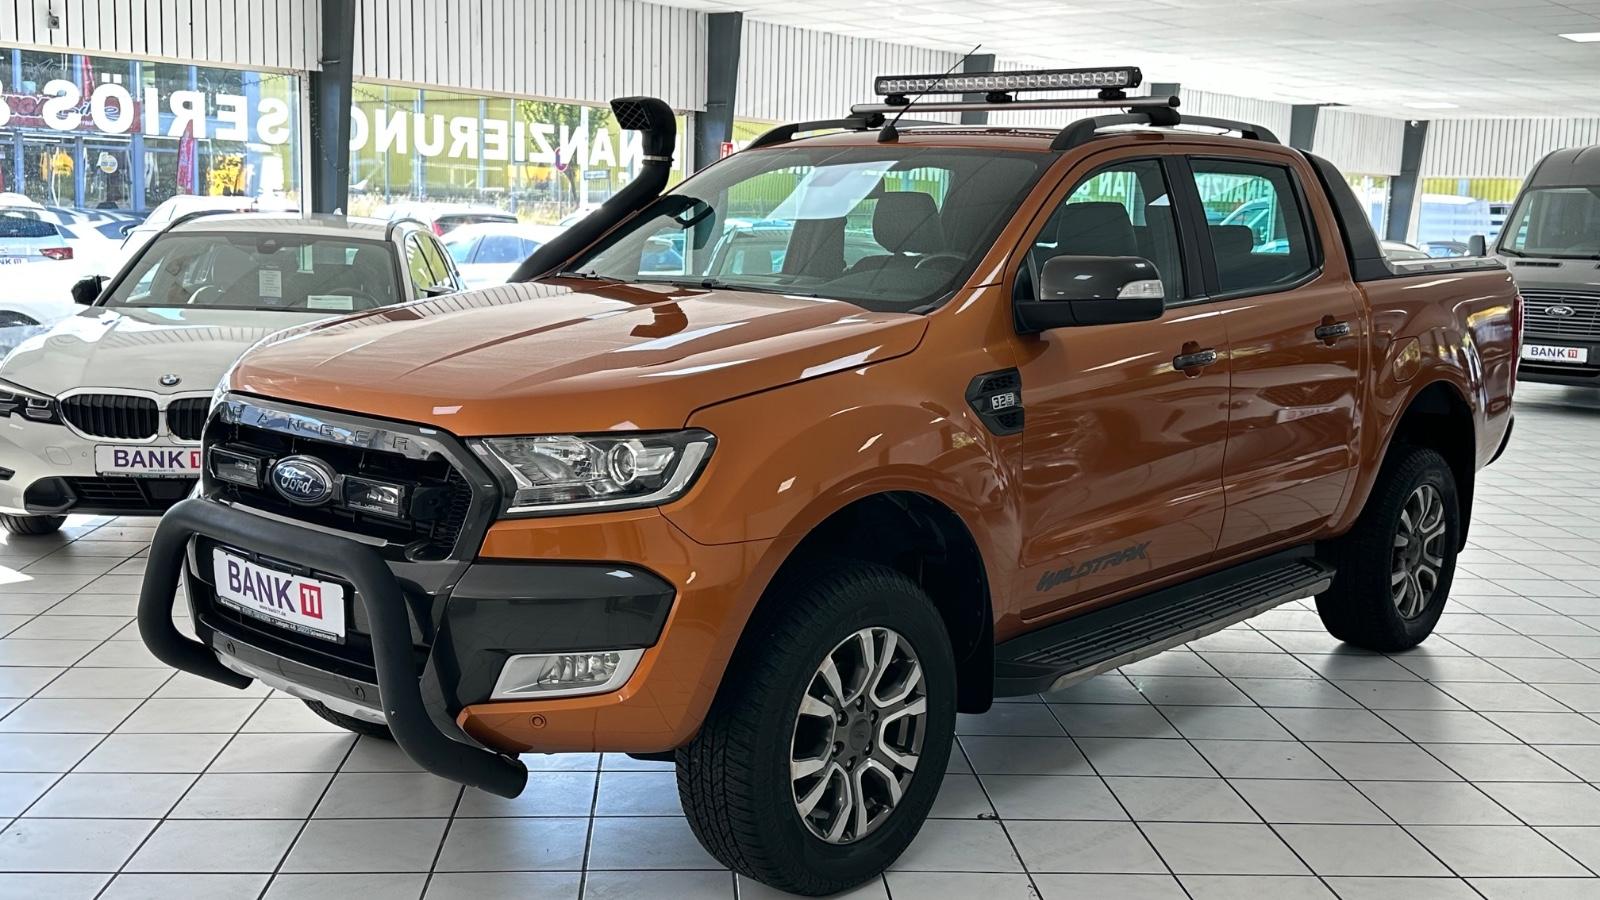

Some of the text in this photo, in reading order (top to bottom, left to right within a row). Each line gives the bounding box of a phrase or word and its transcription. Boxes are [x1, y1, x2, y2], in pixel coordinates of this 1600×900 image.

[1531, 347, 1566, 358] BANK
[230, 404, 410, 451] RANGER
[114, 449, 185, 468] BANK
[280, 467, 330, 496] Ford
[1035, 540, 1152, 592] WILDTRAK
[228, 560, 321, 617] BANK 11
